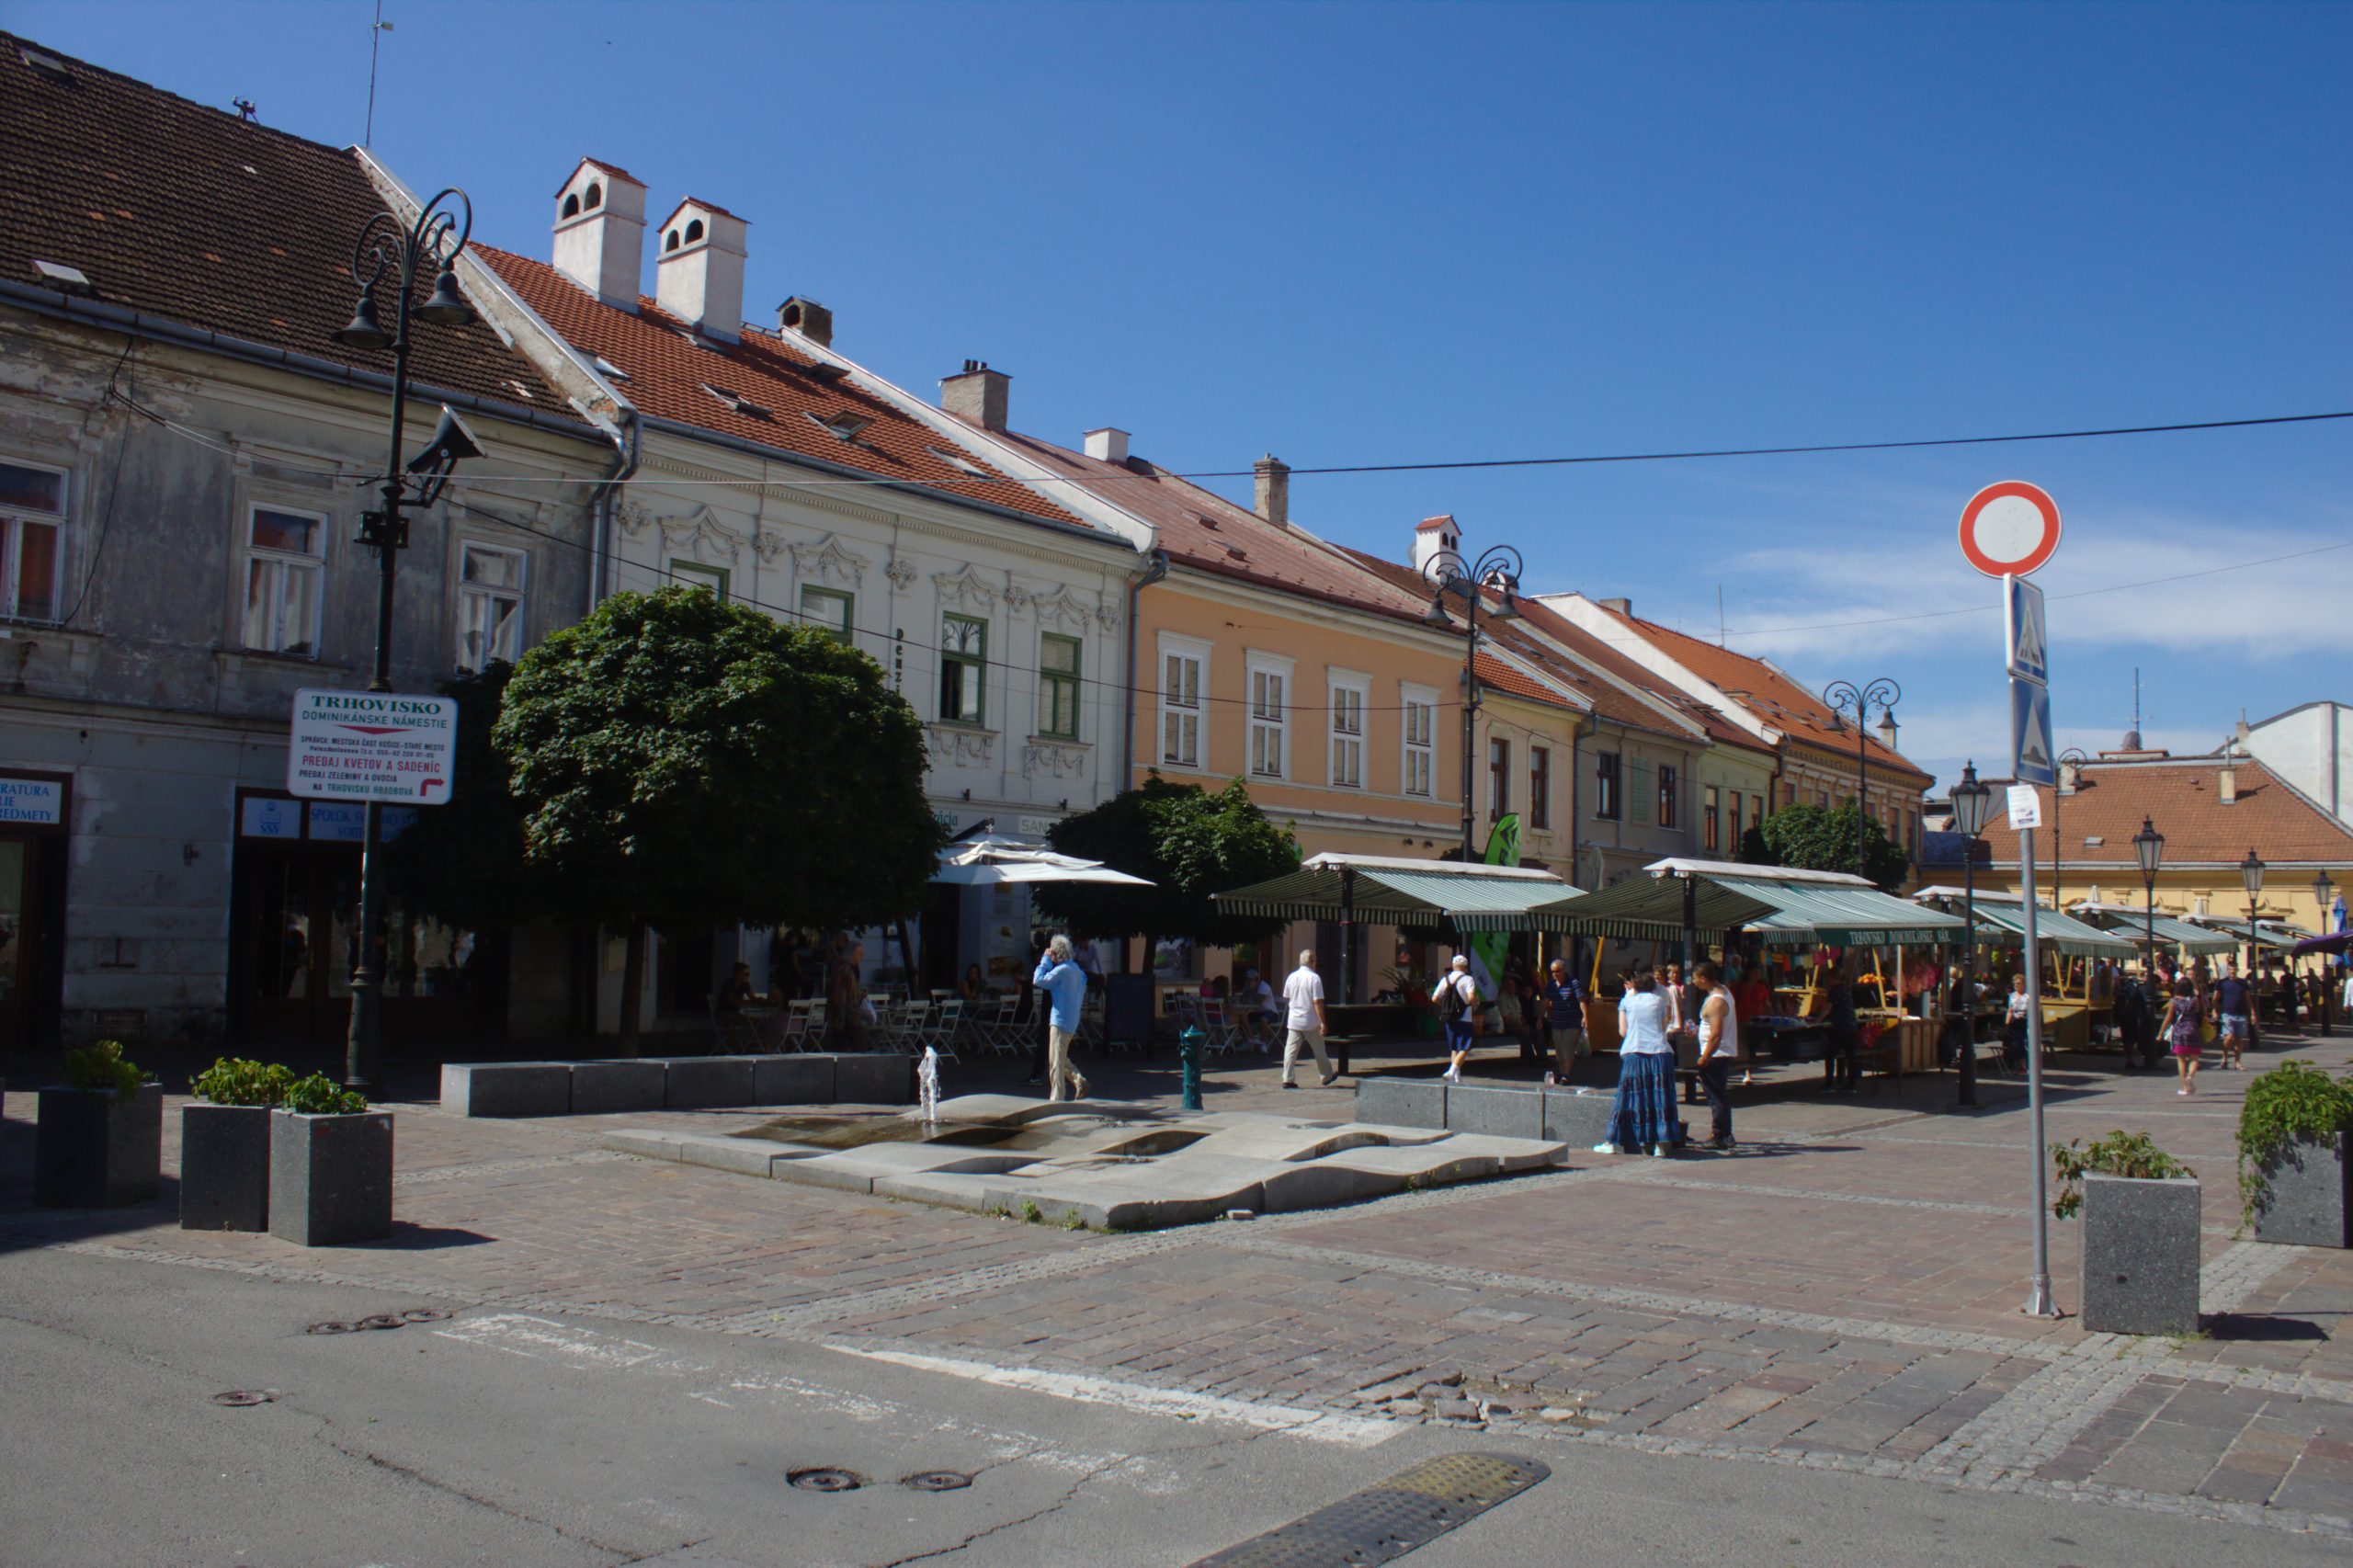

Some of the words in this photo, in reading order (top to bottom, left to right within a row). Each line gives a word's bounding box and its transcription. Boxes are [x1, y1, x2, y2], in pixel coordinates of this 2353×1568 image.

[312, 696, 442, 715] TRHOVISKO
[302, 710, 389, 725] DOMINIKÁNSKE
[392, 714, 448, 729] NÁMESTIE
[425, 743, 446, 752] MESTO
[302, 755, 340, 768] PREDAJ
[344, 757, 382, 770] KVETOV
[386, 760, 393, 771] A
[397, 760, 441, 773] SADENÍC
[299, 769, 325, 779] PREDAJ
[328, 771, 362, 781] ZELENINY
[364, 773, 369, 781] A
[371, 773, 397, 783] OVOCIA
[313, 783, 323, 791] NA
[327, 783, 370, 794] TRHOVISKU
[373, 785, 414, 796] HRADBOVÁ
[312, 808, 349, 824] SPOLOK
